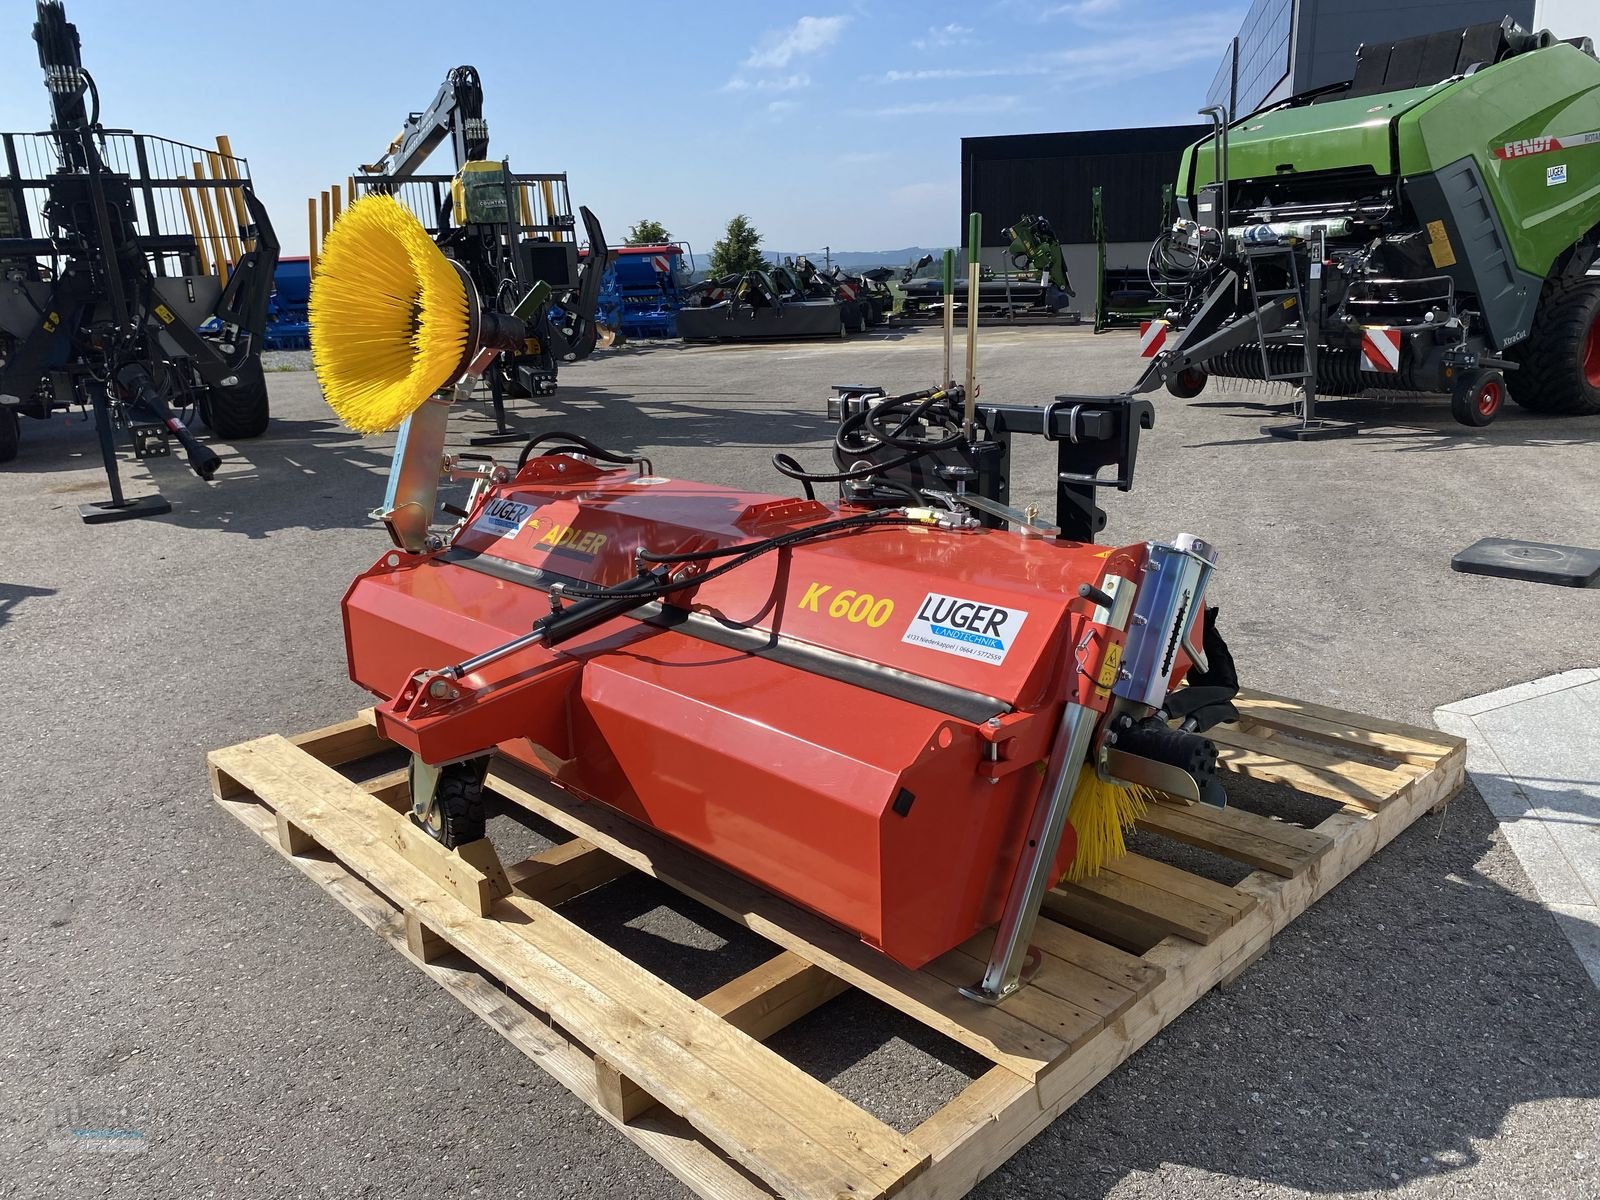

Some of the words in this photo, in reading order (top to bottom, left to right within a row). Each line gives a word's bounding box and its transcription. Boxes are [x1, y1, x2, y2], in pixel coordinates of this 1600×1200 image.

[1505, 135, 1553, 157] FENDT
[1547, 166, 1564, 178] LUGER
[1503, 330, 1526, 346] XtraCut
[485, 500, 528, 523] LUGER
[540, 524, 607, 554] ADLER
[798, 582, 832, 613] K
[829, 590, 894, 628] 600
[917, 595, 1008, 638] LUGER
[906, 633, 919, 641] 4133
[920, 635, 956, 650] Niederkappel
[959, 646, 973, 654] 0664
[977, 651, 1001, 660] 5772559
[935, 625, 997, 648] LANDTECHNIK
